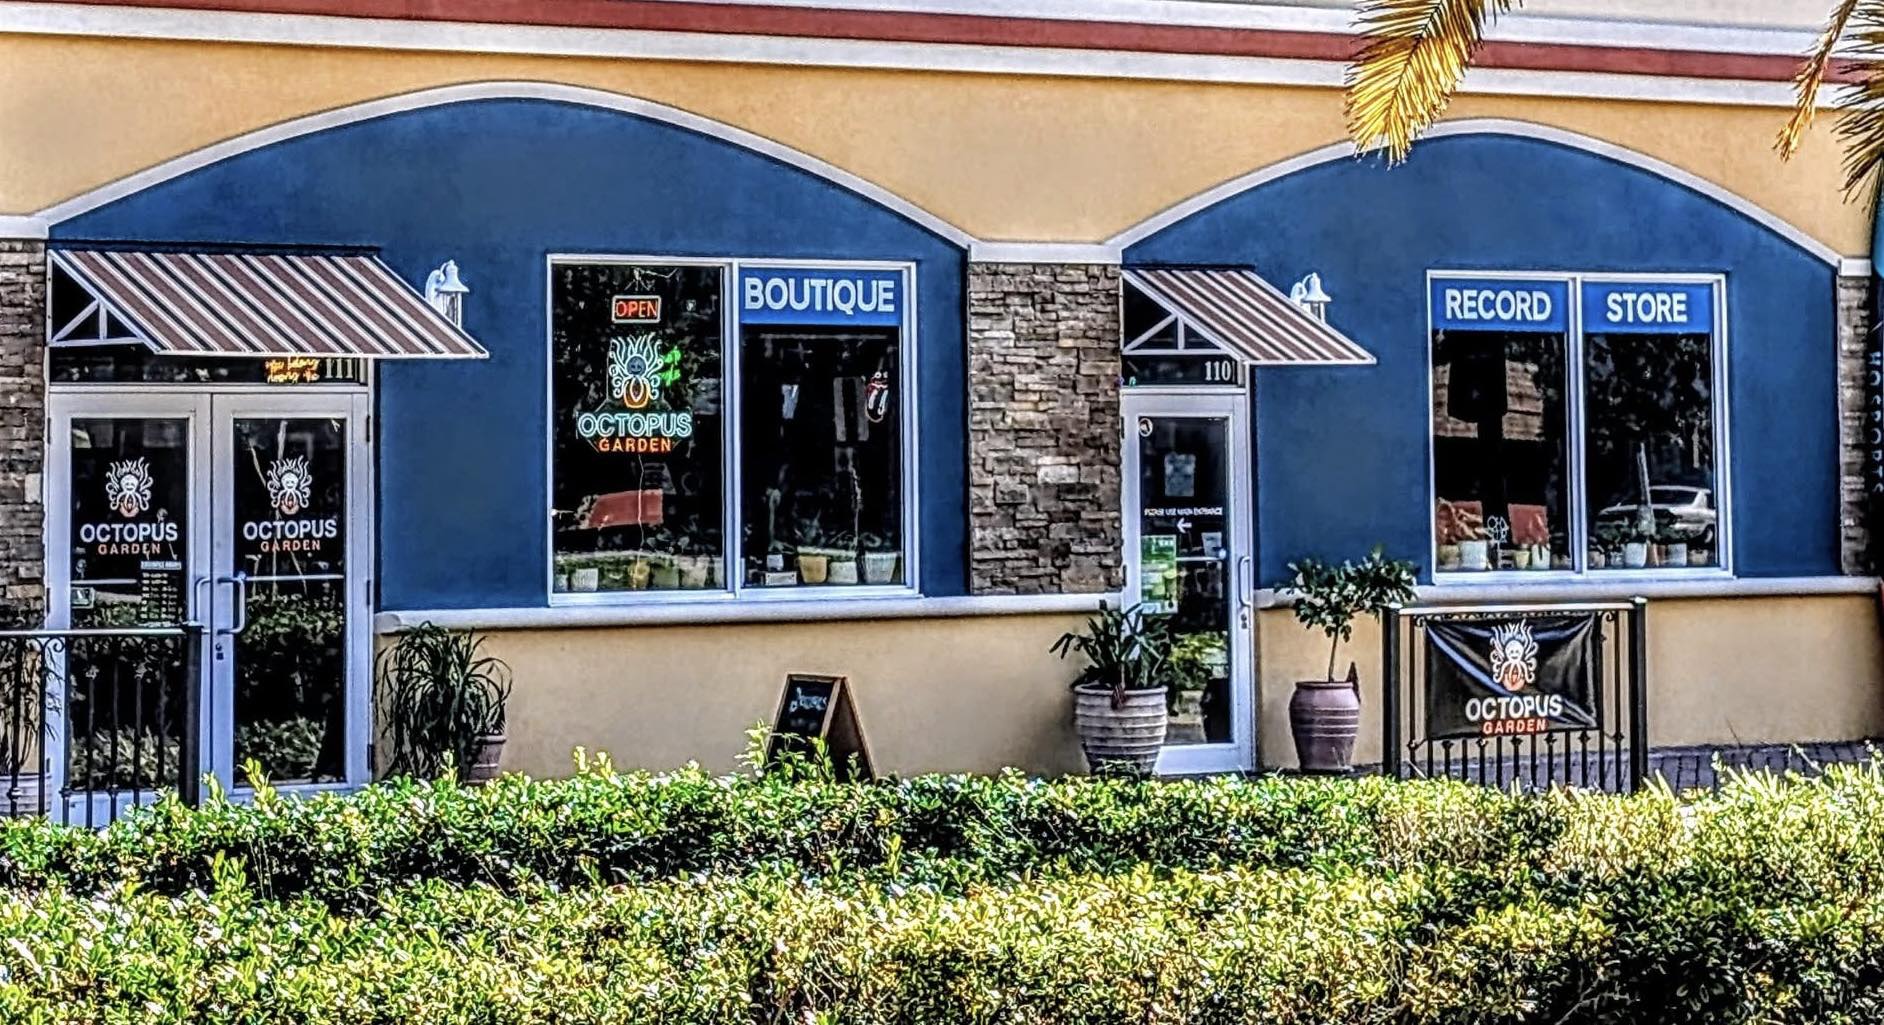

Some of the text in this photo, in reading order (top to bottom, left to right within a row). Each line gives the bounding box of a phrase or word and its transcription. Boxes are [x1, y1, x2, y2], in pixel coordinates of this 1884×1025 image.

[744, 277, 896, 315] BOUTIQUE
[1445, 288, 1688, 323] RECORD STORE
[614, 300, 658, 318] OPEN
[1204, 360, 1231, 382] 110
[577, 411, 693, 438] OCTOPUS
[599, 437, 672, 453] GARDEN
[80, 522, 178, 544] OCTOPUS
[242, 518, 338, 541] OCTOPUS
[97, 543, 161, 556] GARDEN
[260, 539, 321, 552] GARDEN
[1465, 694, 1563, 722] OCTOPUS
[1482, 718, 1547, 735] GARDEN
